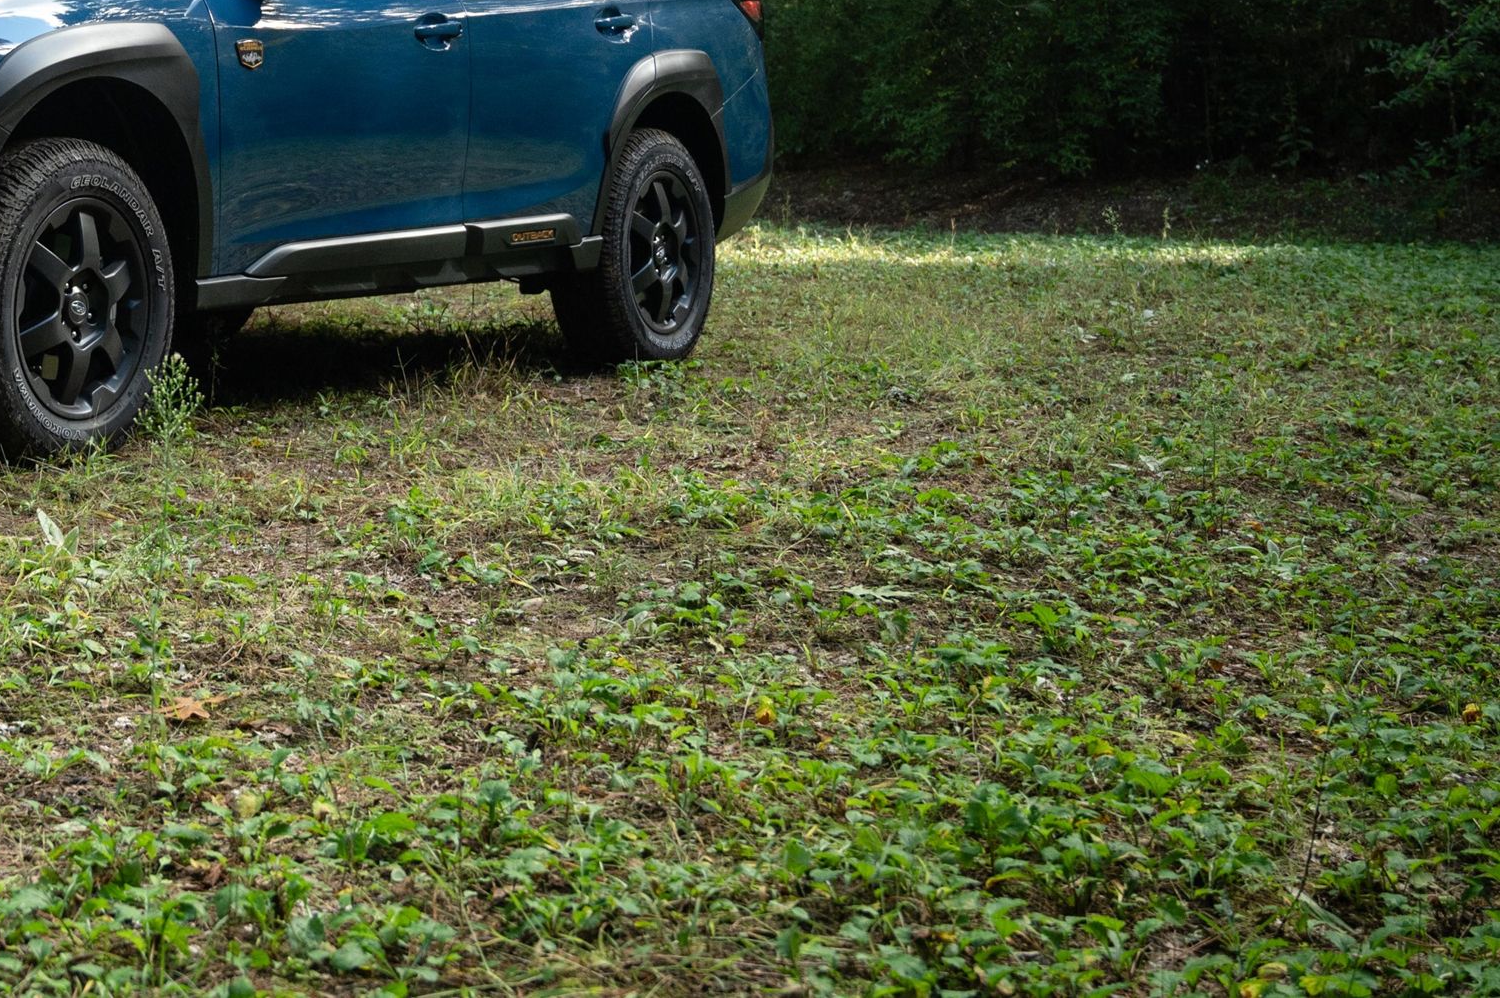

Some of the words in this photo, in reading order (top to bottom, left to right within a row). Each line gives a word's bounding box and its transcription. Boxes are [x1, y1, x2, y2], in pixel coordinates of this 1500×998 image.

[70, 174, 155, 237] GEOLANDAR
[152, 248, 167, 291] A/T
[13, 367, 84, 441] YOKOHAMA
